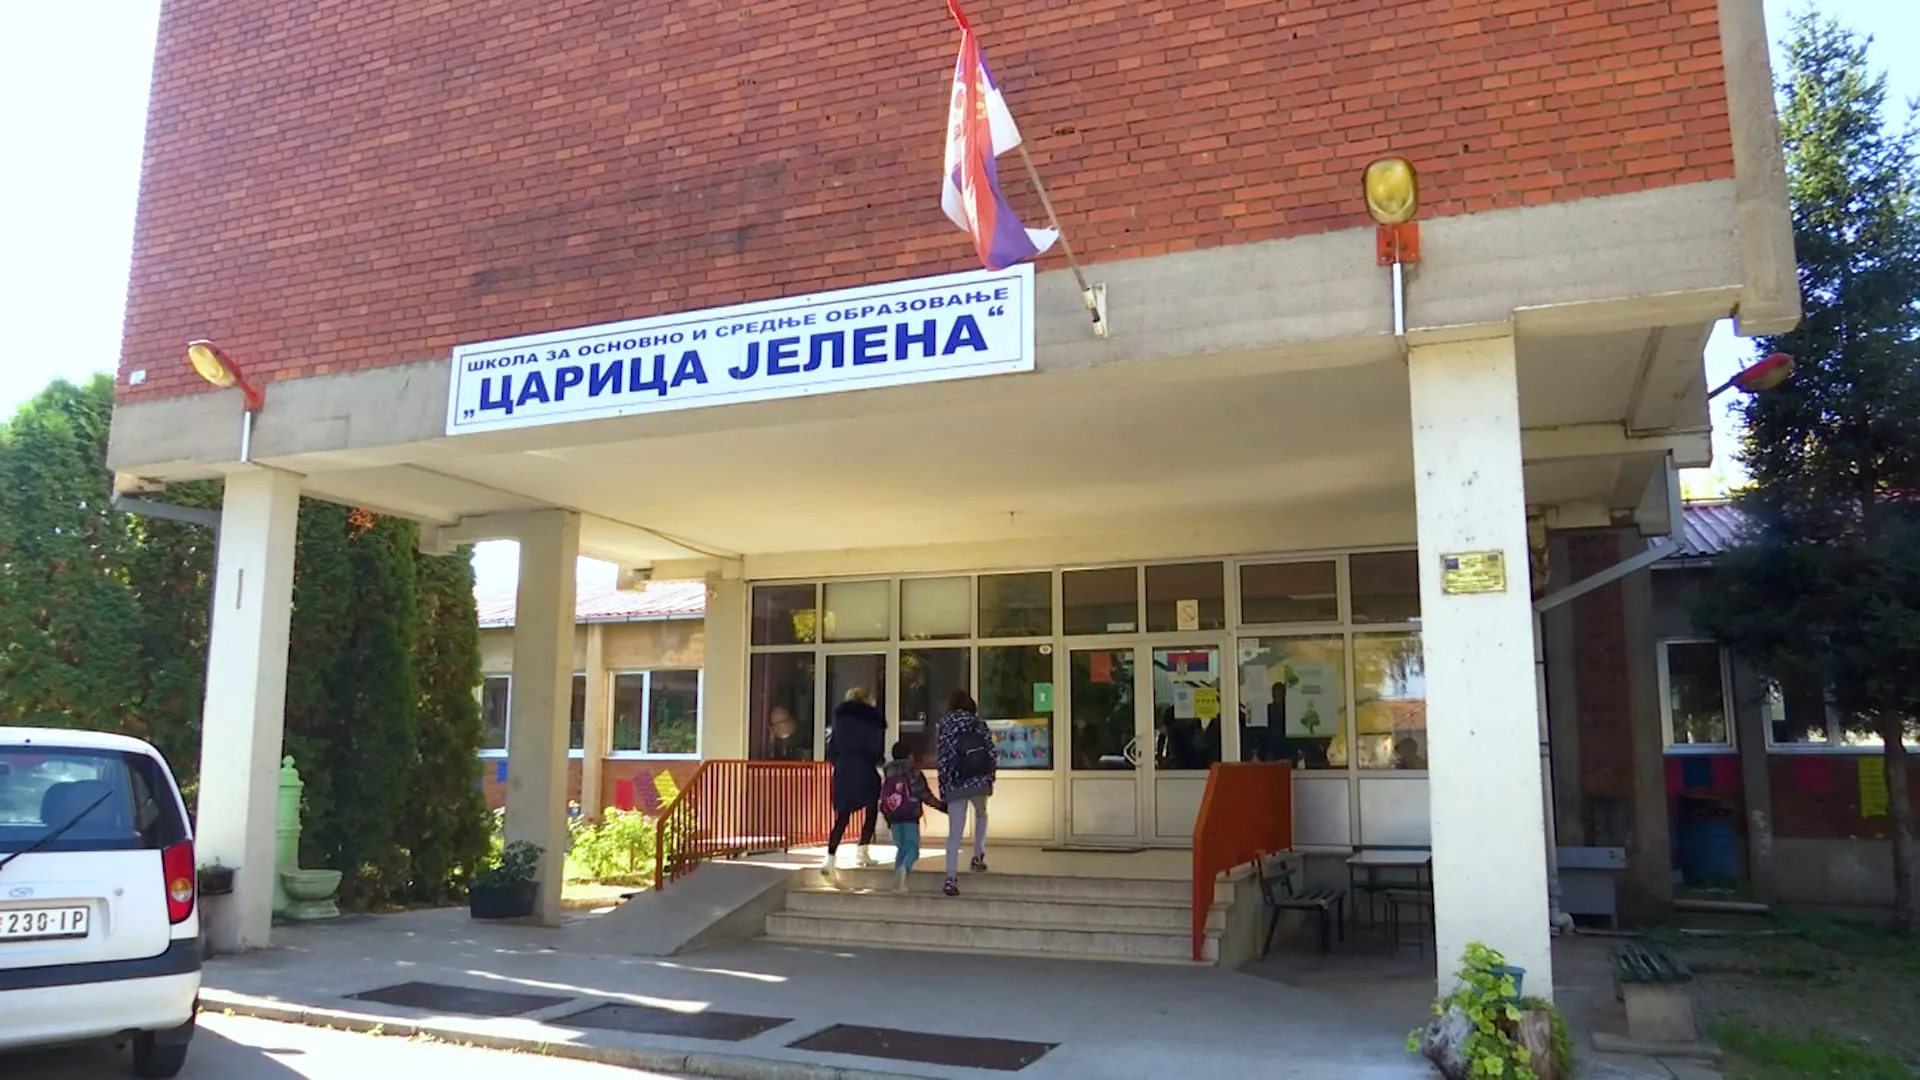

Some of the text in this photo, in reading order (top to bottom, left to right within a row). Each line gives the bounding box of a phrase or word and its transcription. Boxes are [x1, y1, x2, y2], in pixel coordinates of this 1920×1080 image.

[467, 287, 1009, 372] ШКОЛА ЗА ОСНОВНО И СРЕДЊЕ ОБРАЗОВАЊЕ
[463, 349, 709, 419] „ЦАРИЦА
